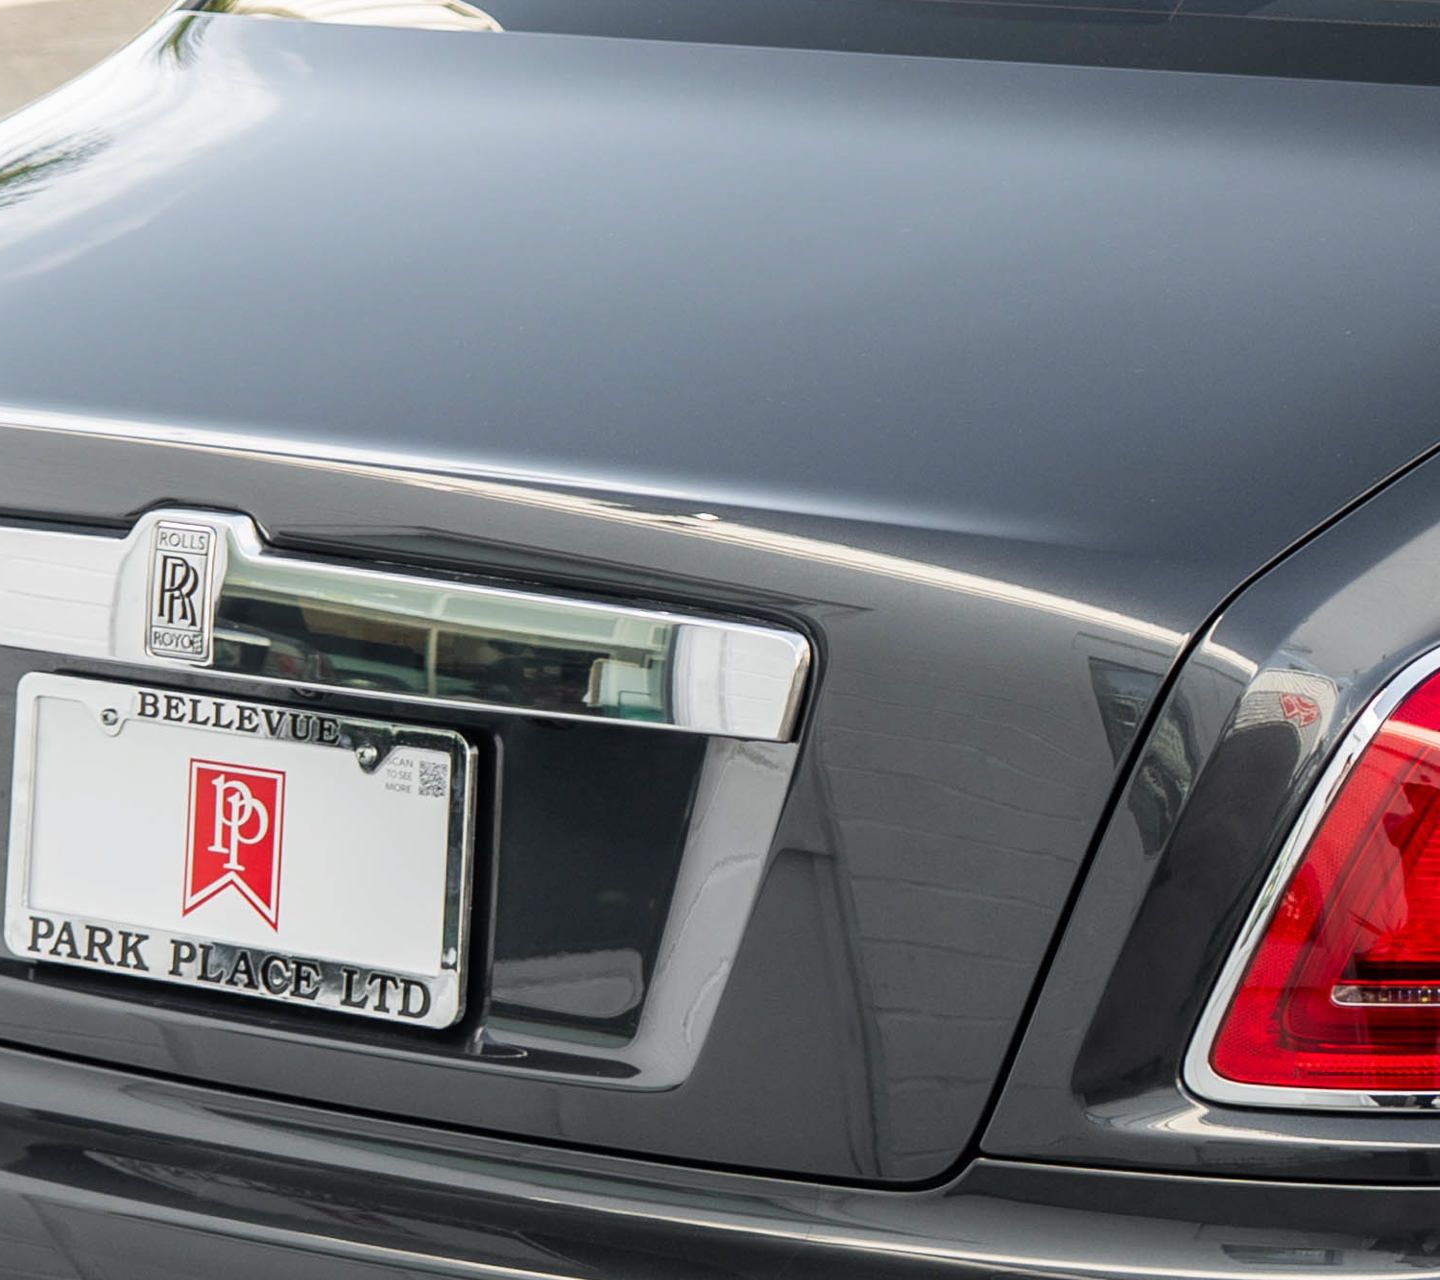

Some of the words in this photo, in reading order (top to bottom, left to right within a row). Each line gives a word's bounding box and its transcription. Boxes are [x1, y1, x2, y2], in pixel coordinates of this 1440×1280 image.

[159, 532, 205, 550] ROLLS
[158, 555, 199, 627] RR
[137, 691, 340, 744] BELLEVUE
[385, 782, 412, 793] MORE
[28, 916, 150, 972] PARK
[168, 939, 322, 1001] PLACE
[340, 967, 432, 1019] LTD
